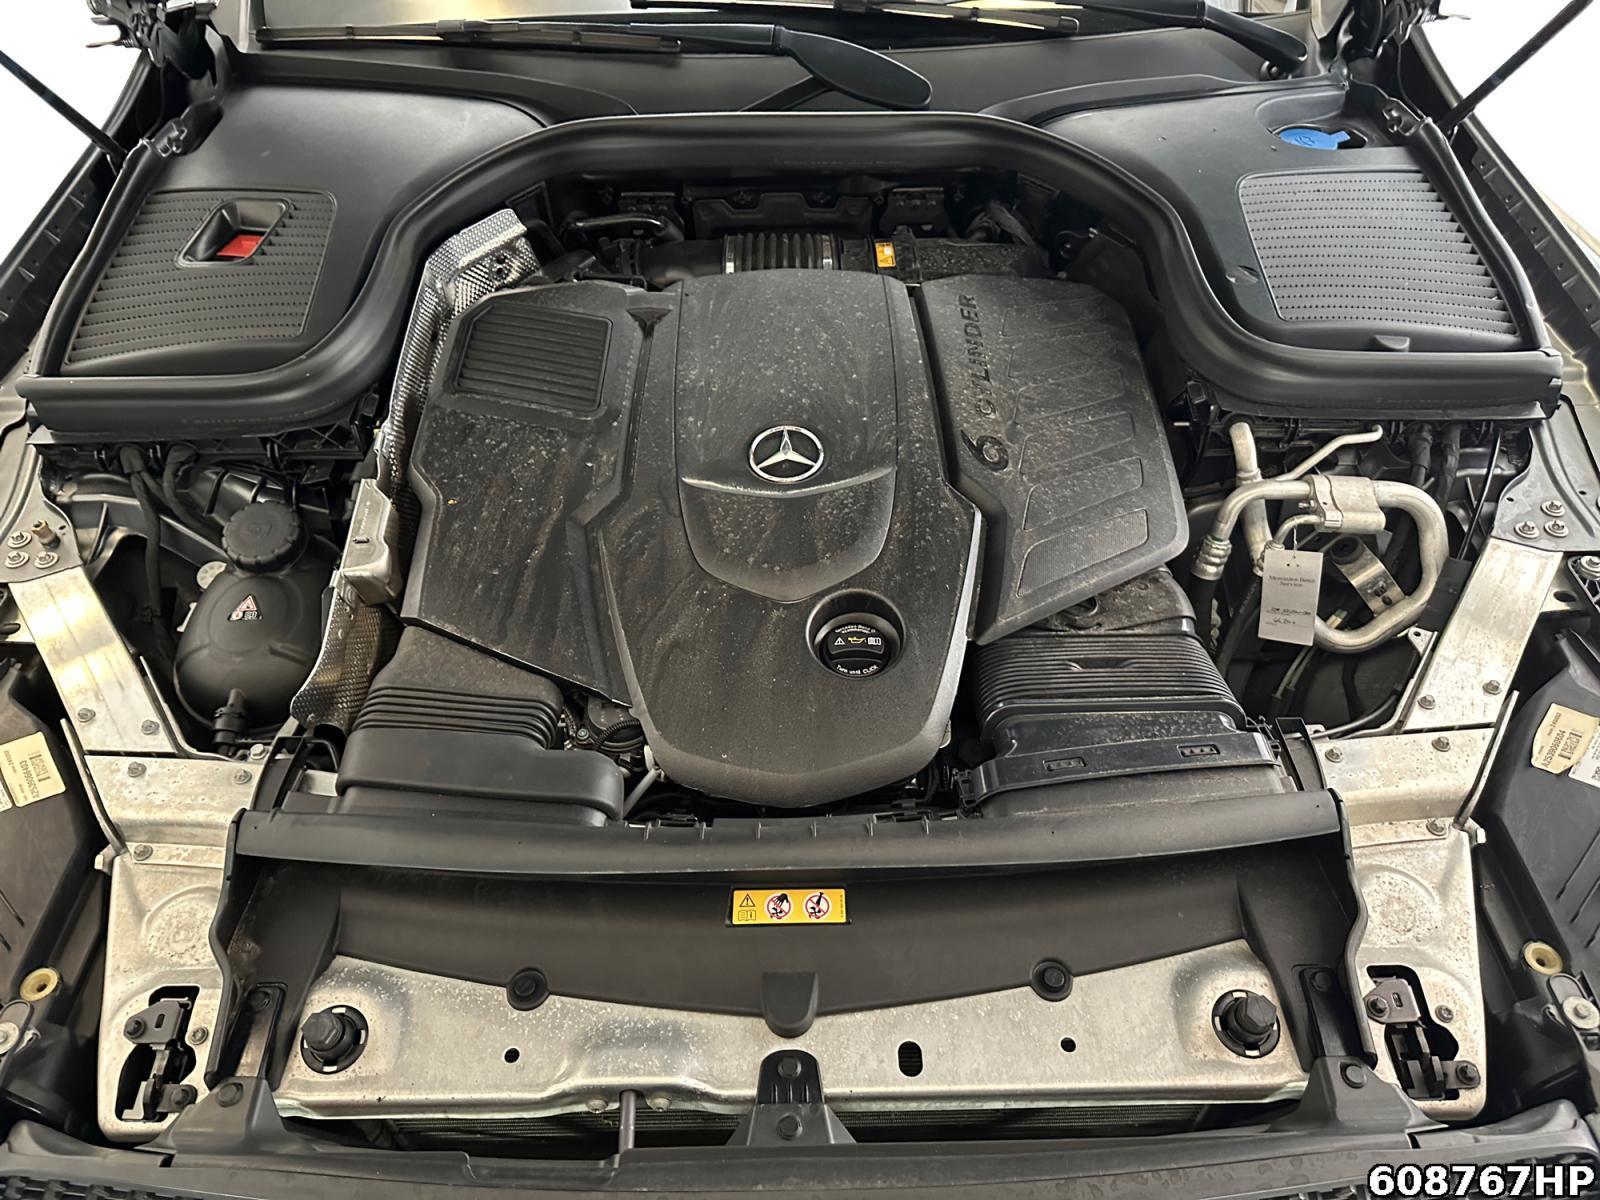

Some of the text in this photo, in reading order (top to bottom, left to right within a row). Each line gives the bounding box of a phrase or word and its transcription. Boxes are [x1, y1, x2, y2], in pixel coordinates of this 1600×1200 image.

[959, 294, 1009, 472] 6 CYLINDER
[837, 664, 848, 673] Turn
[862, 664, 878, 674] CLICK
